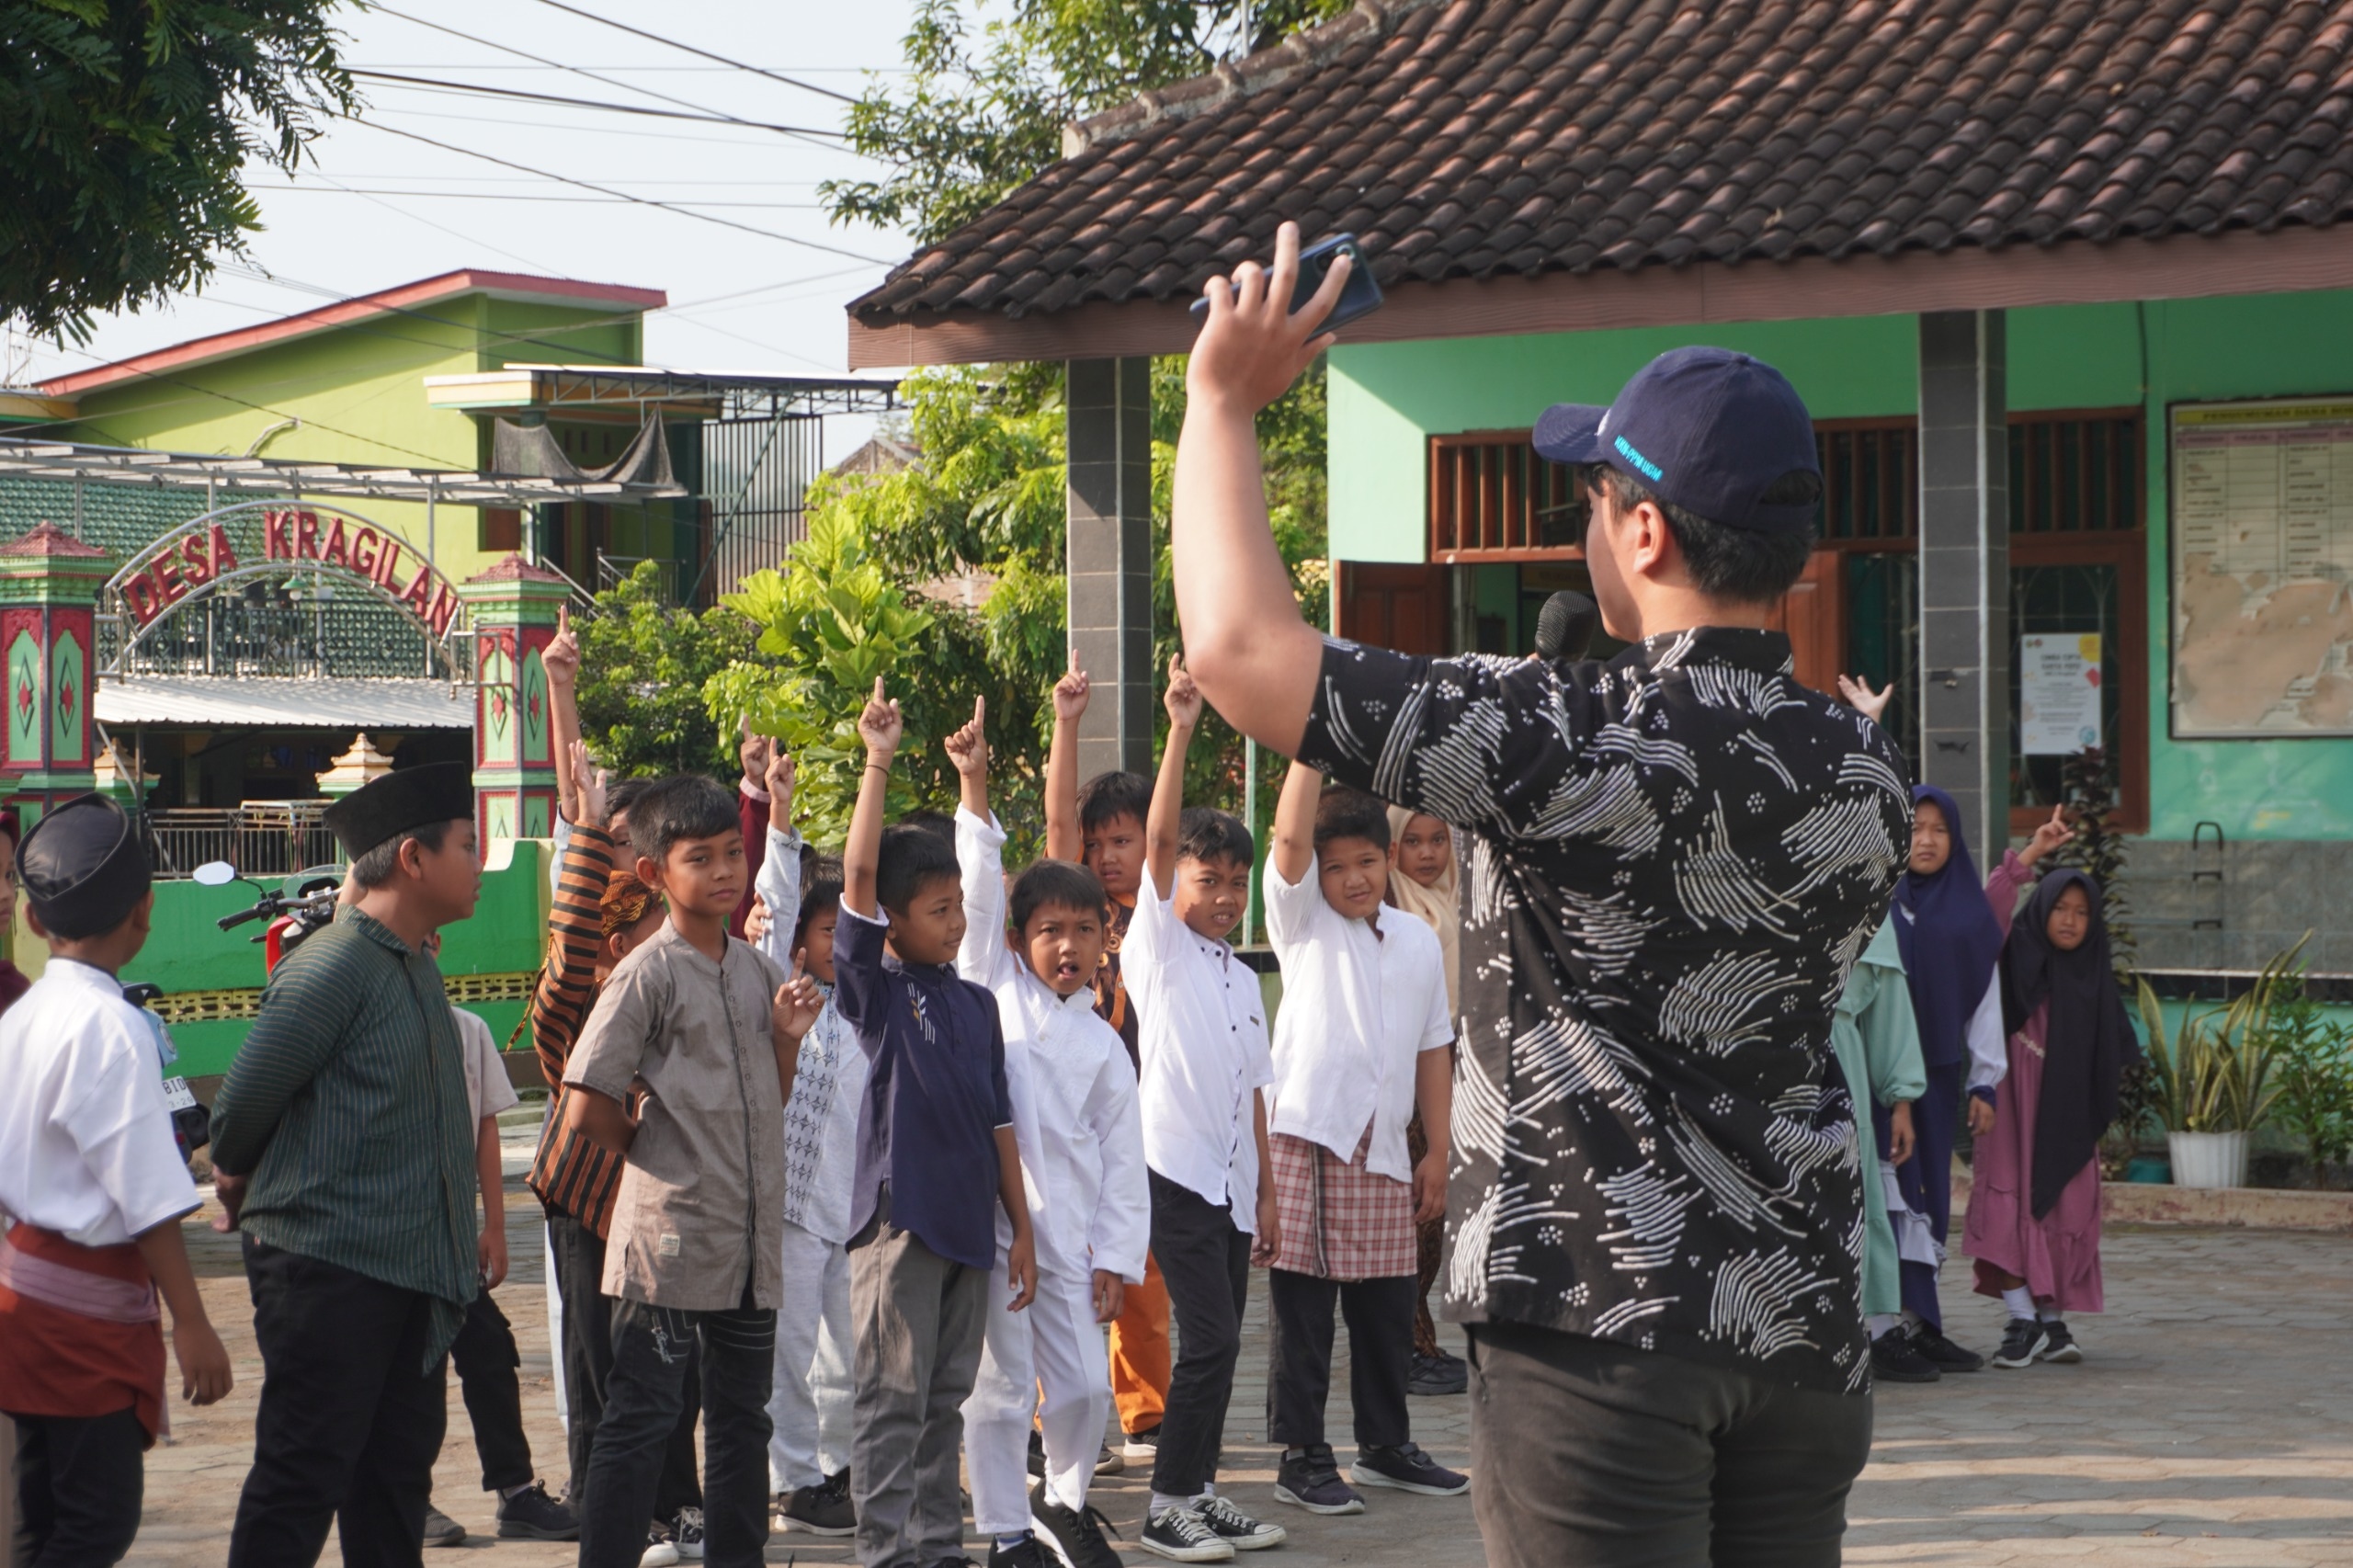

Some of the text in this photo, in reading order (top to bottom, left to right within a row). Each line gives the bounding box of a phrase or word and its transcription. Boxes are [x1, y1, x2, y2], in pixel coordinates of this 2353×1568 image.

[1641, 460, 1664, 483] UGM
[124, 510, 459, 637] DESA KRAGILAN
[162, 1078, 187, 1095] BID
